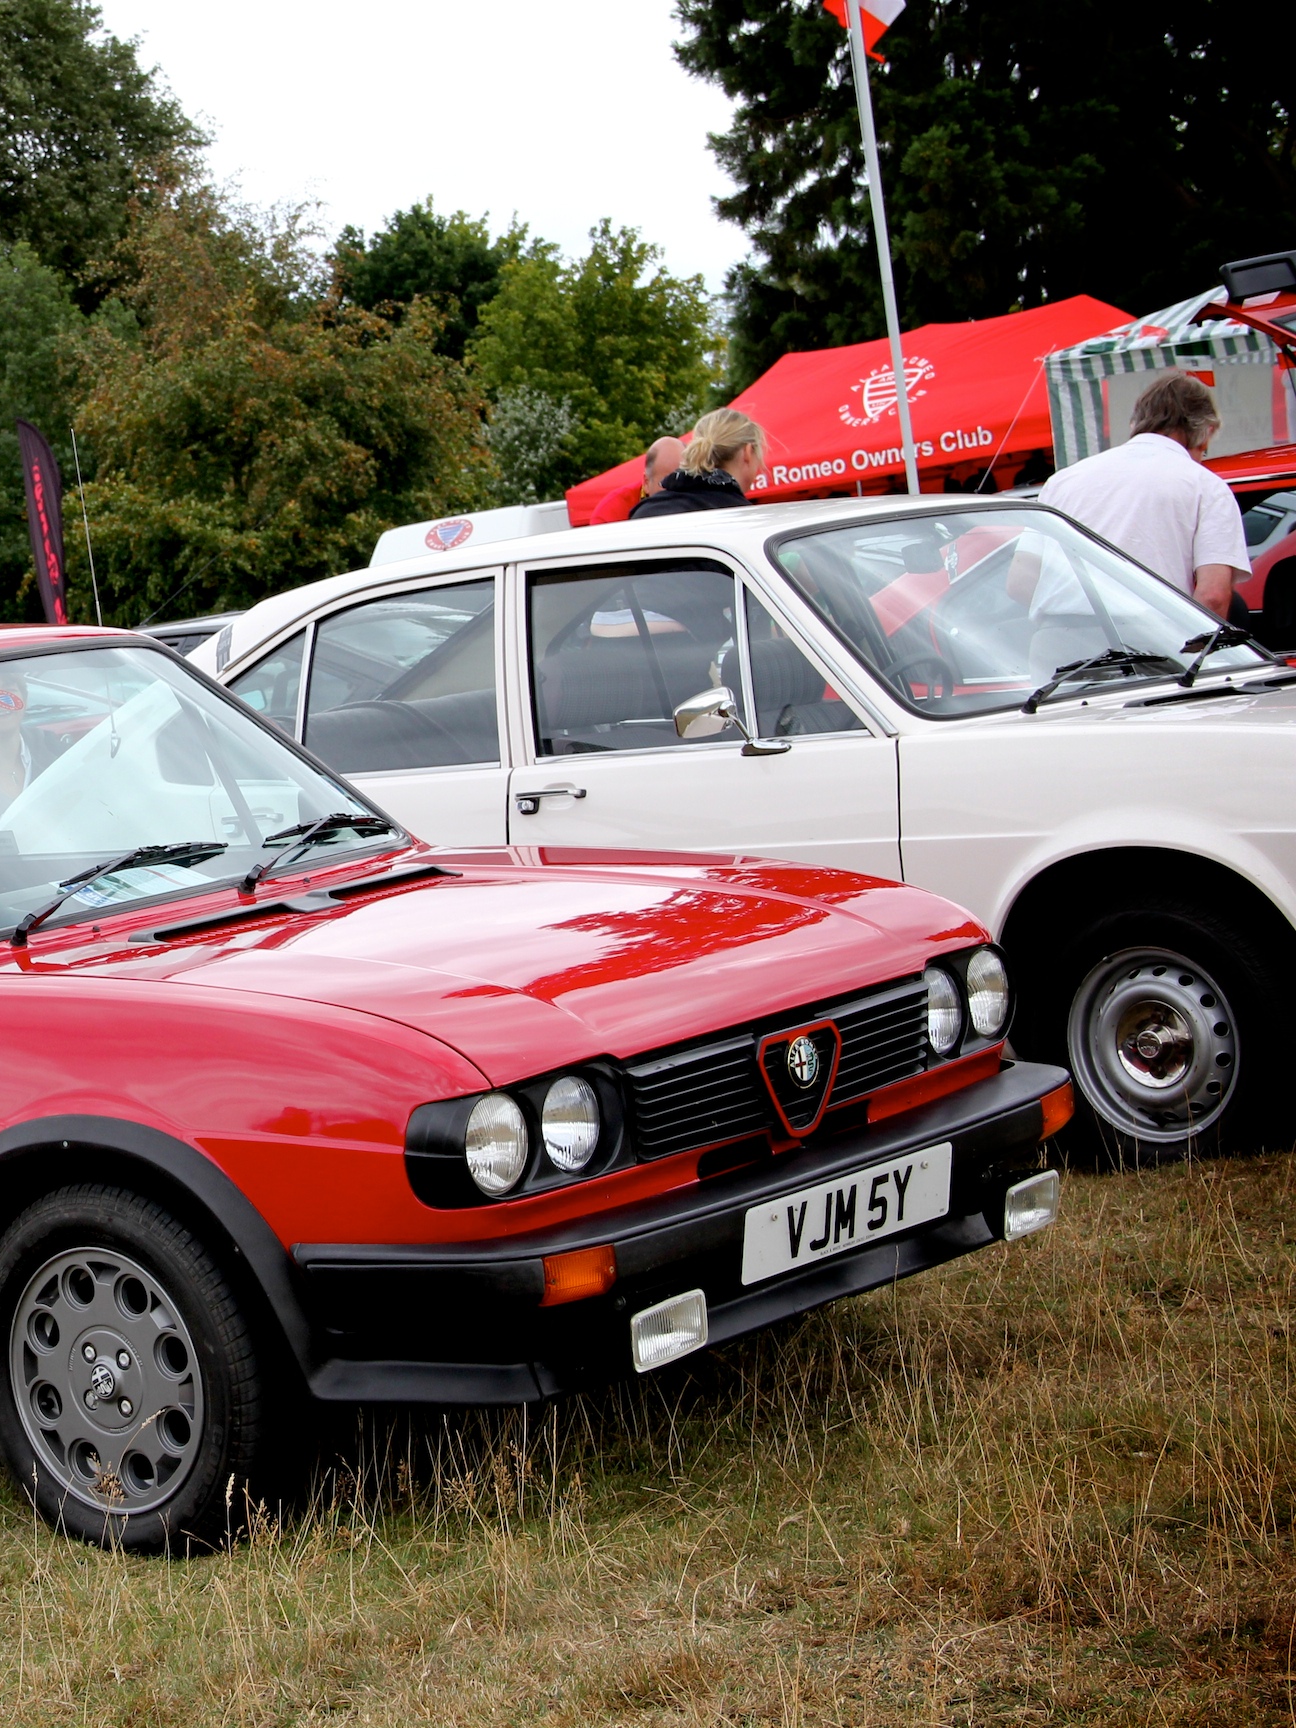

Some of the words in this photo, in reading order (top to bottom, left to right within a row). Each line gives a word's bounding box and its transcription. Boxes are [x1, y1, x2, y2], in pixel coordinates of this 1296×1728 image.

[772, 458, 846, 485] Romeo
[939, 426, 993, 453] Club
[787, 1184, 857, 1259] VJM
[867, 1164, 913, 1231] 5Y
